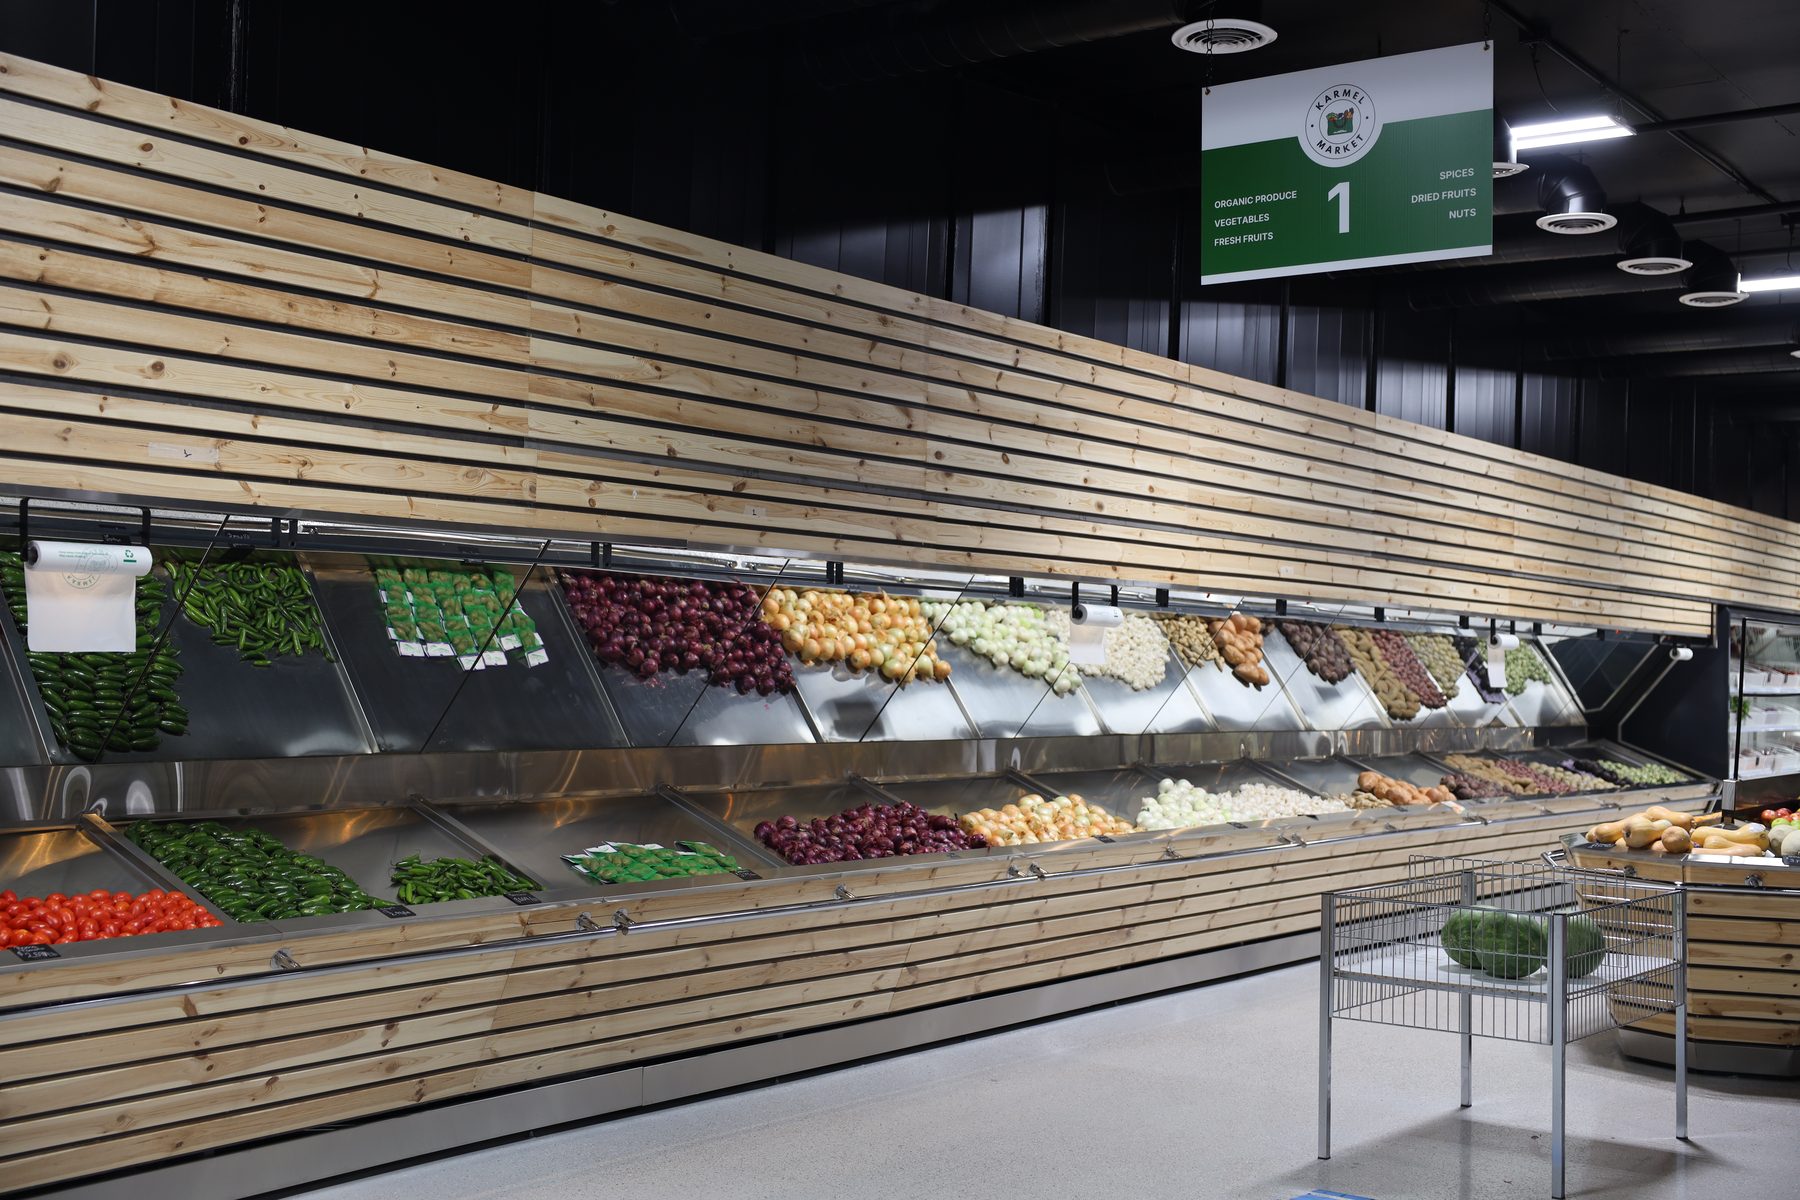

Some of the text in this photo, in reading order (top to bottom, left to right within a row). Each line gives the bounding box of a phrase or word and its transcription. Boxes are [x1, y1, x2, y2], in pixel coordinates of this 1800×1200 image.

[1315, 88, 1365, 111] KARMEL
[1316, 133, 1364, 155] MARKET
[1439, 167, 1475, 180] SPICES
[1213, 190, 1298, 209] ORGANIC PRODUCE
[1411, 187, 1476, 204] DRIED FRUITS
[1327, 180, 1350, 235] 1
[1448, 207, 1476, 219] NUTS
[1213, 213, 1270, 228] VEGETABLES
[1213, 231, 1274, 247] FRESH FRUITS
